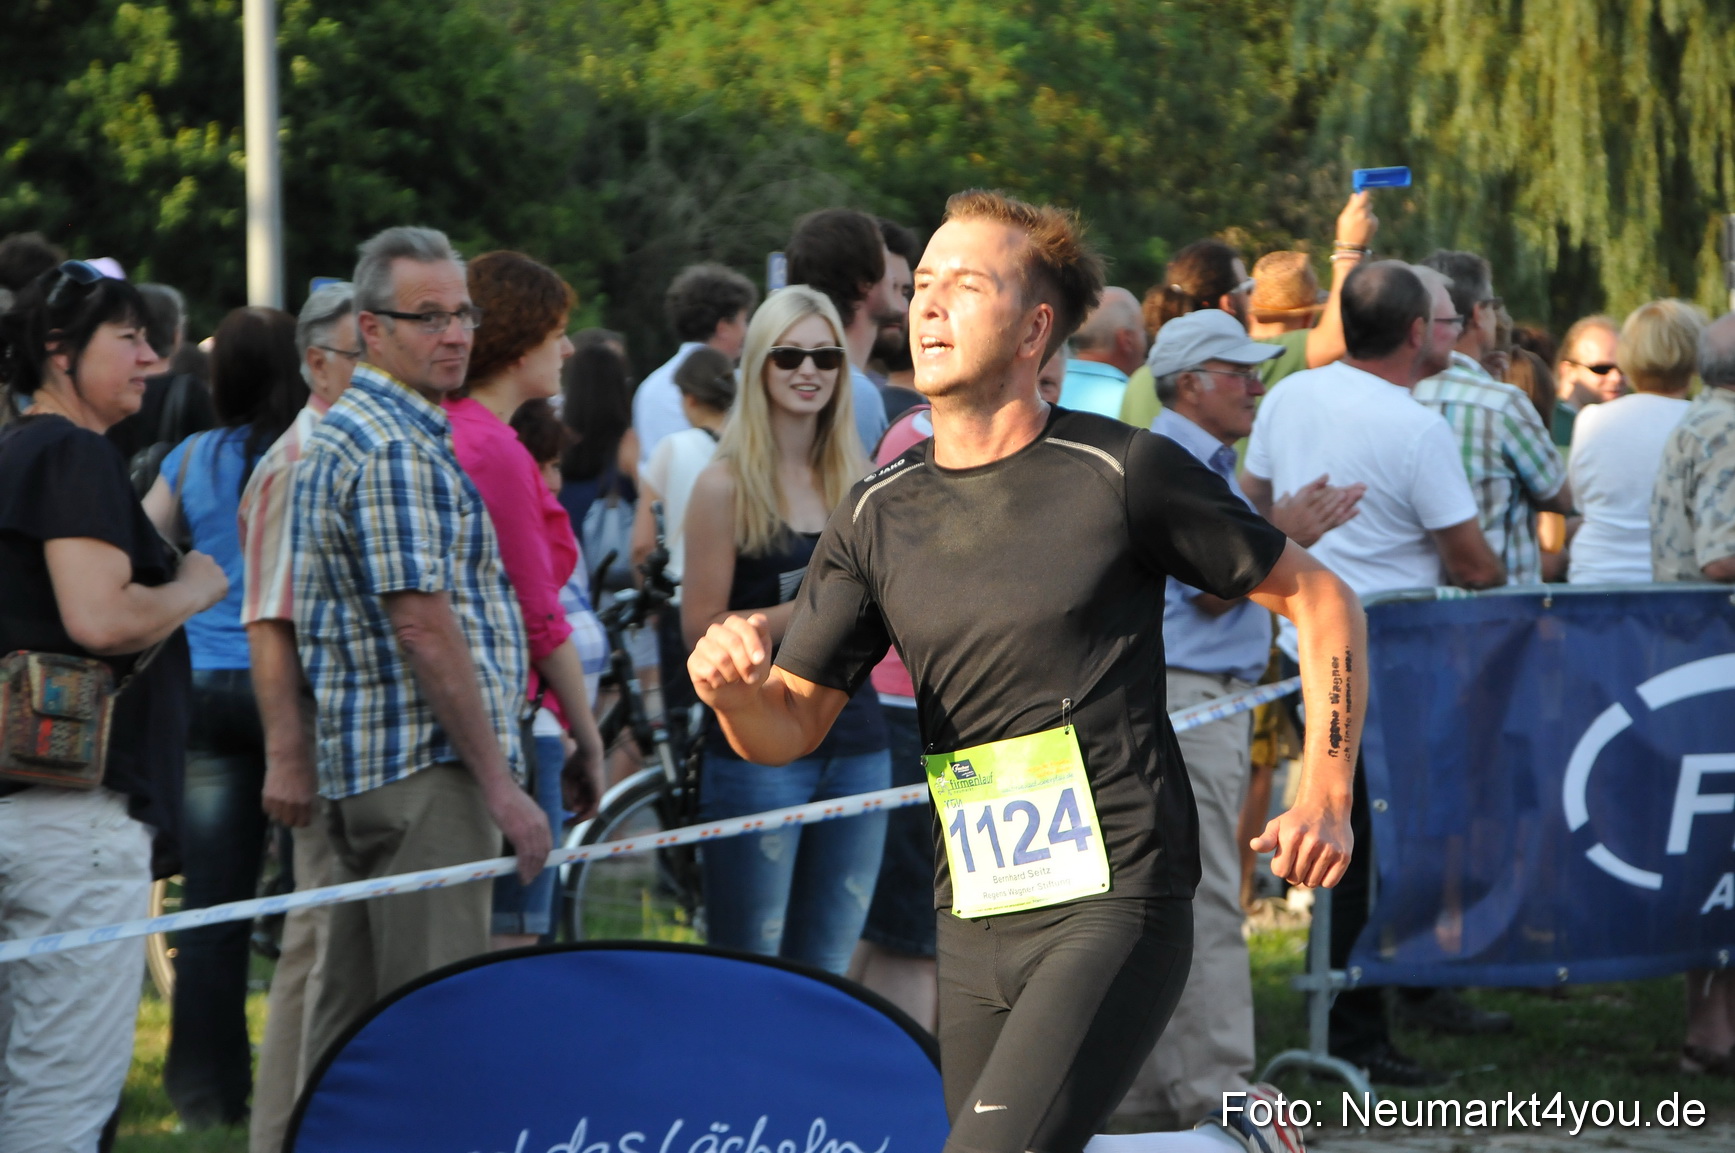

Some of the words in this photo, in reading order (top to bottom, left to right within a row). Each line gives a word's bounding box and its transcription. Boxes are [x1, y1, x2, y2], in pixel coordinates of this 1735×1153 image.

[878, 458, 906, 476] JAKO
[949, 772, 993, 790] firmenlauf
[949, 787, 1093, 873] 1124
[992, 871, 1026, 884] Bernhard
[1029, 867, 1051, 877] Seitz
[1008, 886, 1034, 898] Wagner
